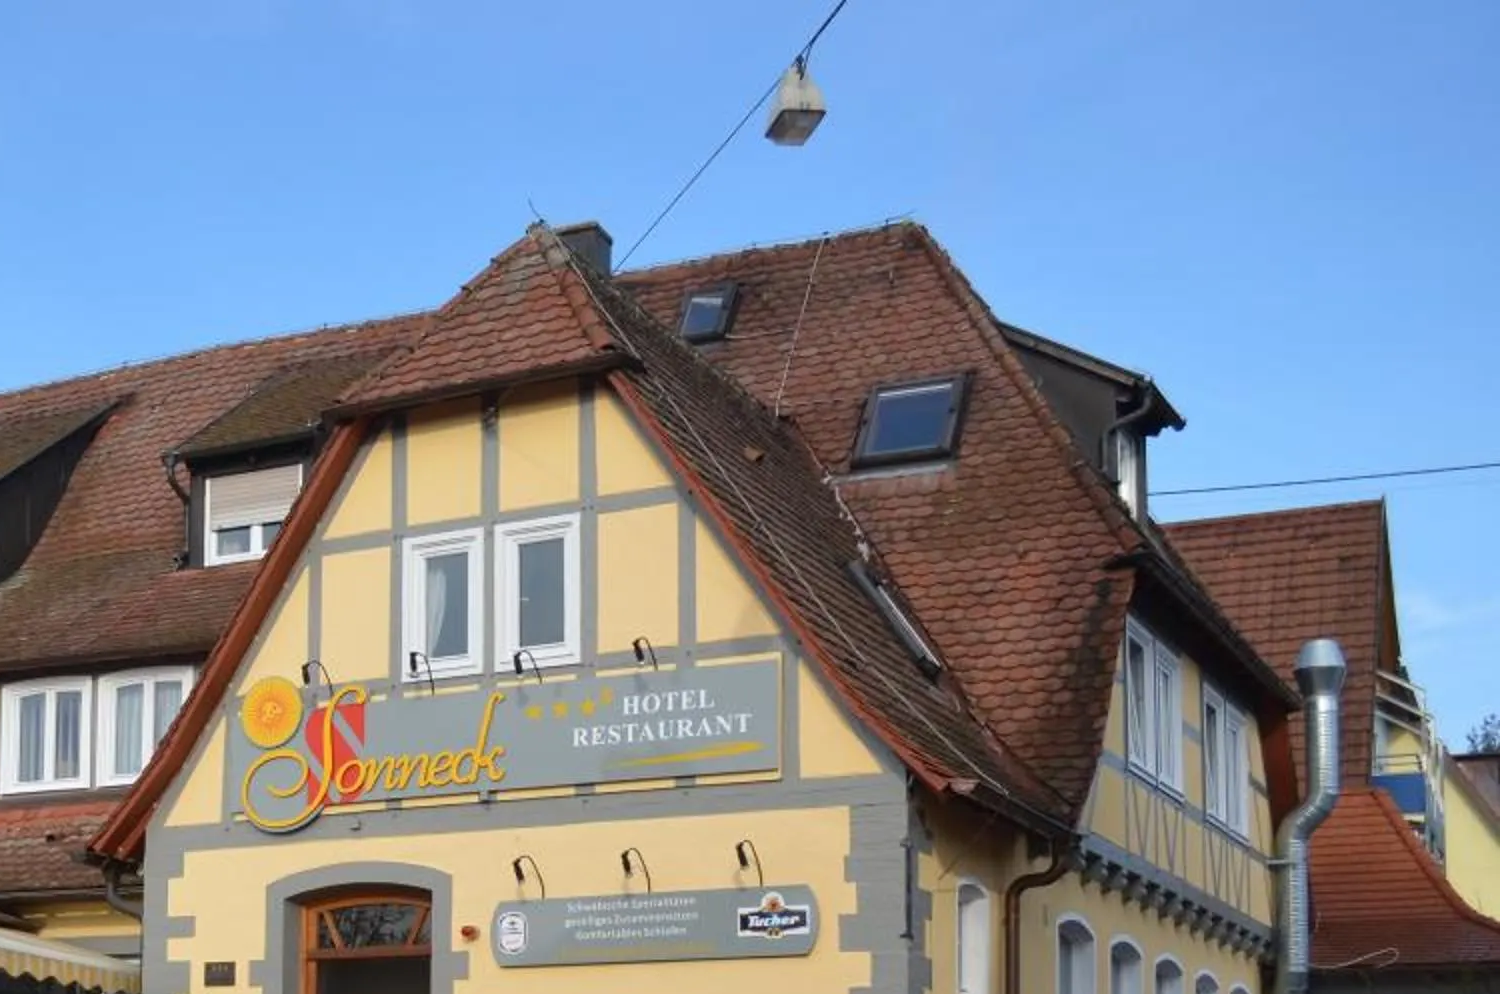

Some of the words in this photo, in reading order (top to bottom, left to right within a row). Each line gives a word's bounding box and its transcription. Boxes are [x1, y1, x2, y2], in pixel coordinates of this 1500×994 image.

[622, 689, 715, 716] HOTEL
[572, 713, 753, 748] RESTAURANT
[241, 685, 506, 830] Sonneck
[746, 914, 801, 929] Tucher
